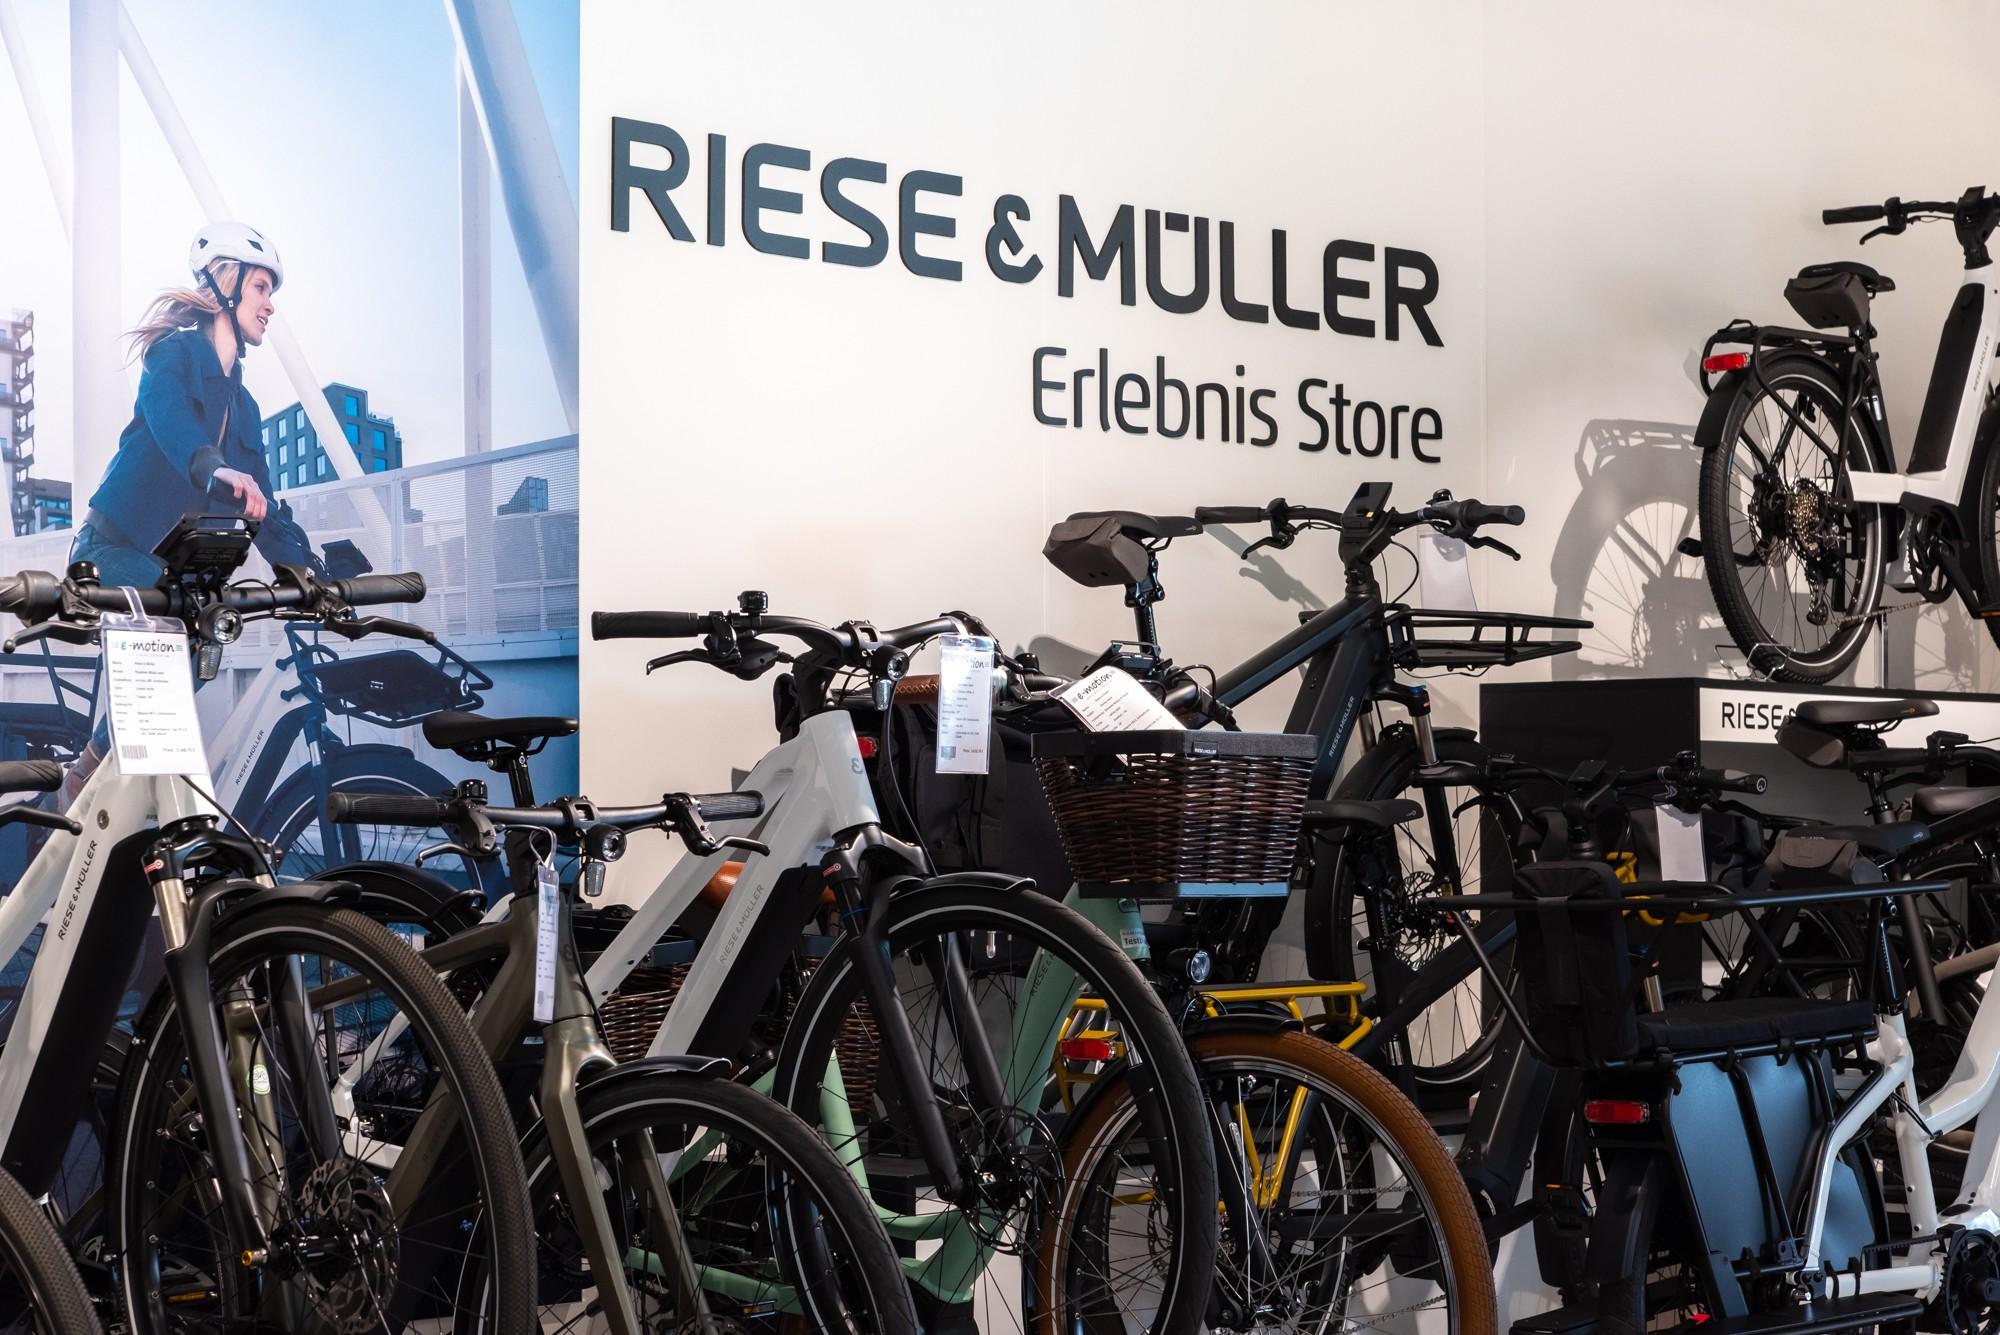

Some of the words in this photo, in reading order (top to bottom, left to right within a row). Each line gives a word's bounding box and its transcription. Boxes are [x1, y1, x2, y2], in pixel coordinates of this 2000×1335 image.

[610, 116, 963, 282] RIESE
[985, 194, 1044, 284] &
[1057, 194, 1444, 347] MÜLLER
[1032, 346, 1278, 447] Erlebnis
[1298, 377, 1442, 464] Store
[121, 639, 174, 652] e-motion
[1077, 672, 1112, 700] e-motion
[1722, 702, 1783, 730] RIESE
[58, 901, 77, 941] RIESE
[75, 840, 98, 894] MÜLLER
[720, 931, 739, 964] RIESE
